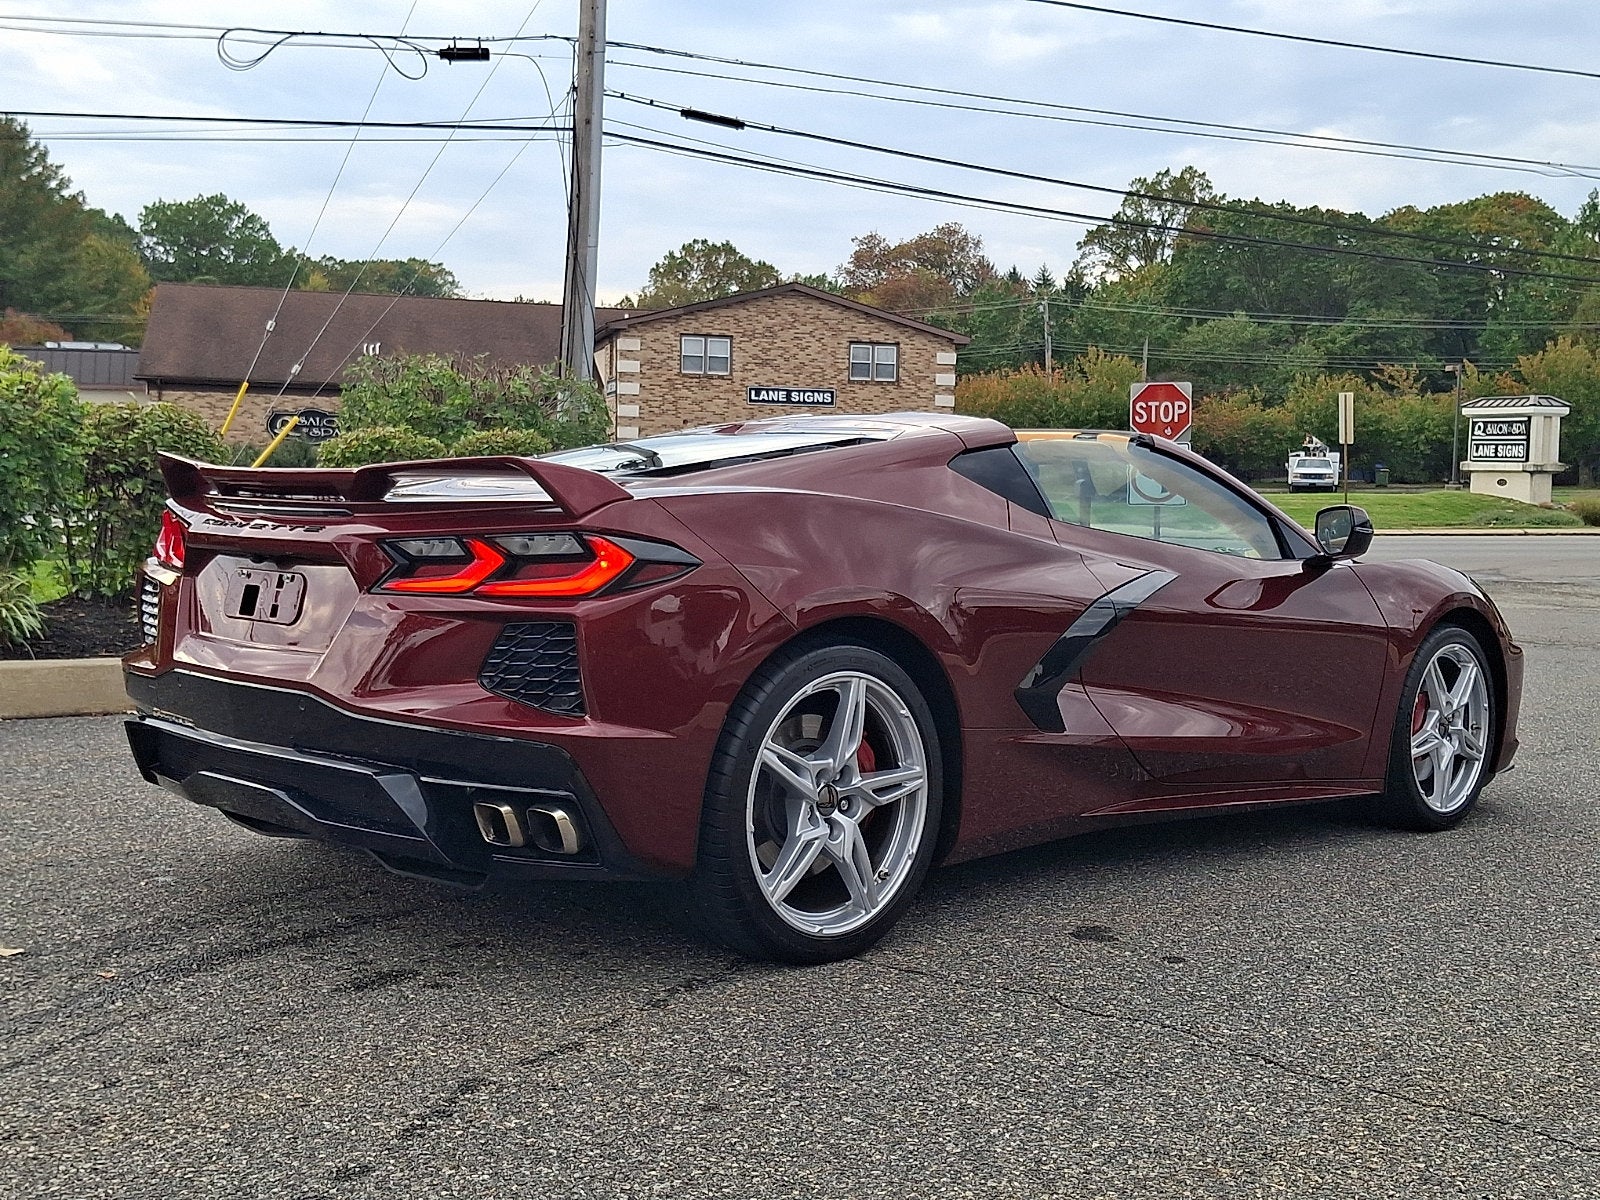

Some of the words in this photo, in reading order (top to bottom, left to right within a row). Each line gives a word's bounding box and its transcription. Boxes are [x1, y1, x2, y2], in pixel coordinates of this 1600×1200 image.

[751, 389, 787, 401] LANE
[791, 391, 832, 403] SIGNS
[1135, 401, 1187, 424] STOP
[1473, 421, 1487, 436] Q
[1473, 444, 1495, 457] LANE
[1496, 444, 1524, 457] SIGNS
